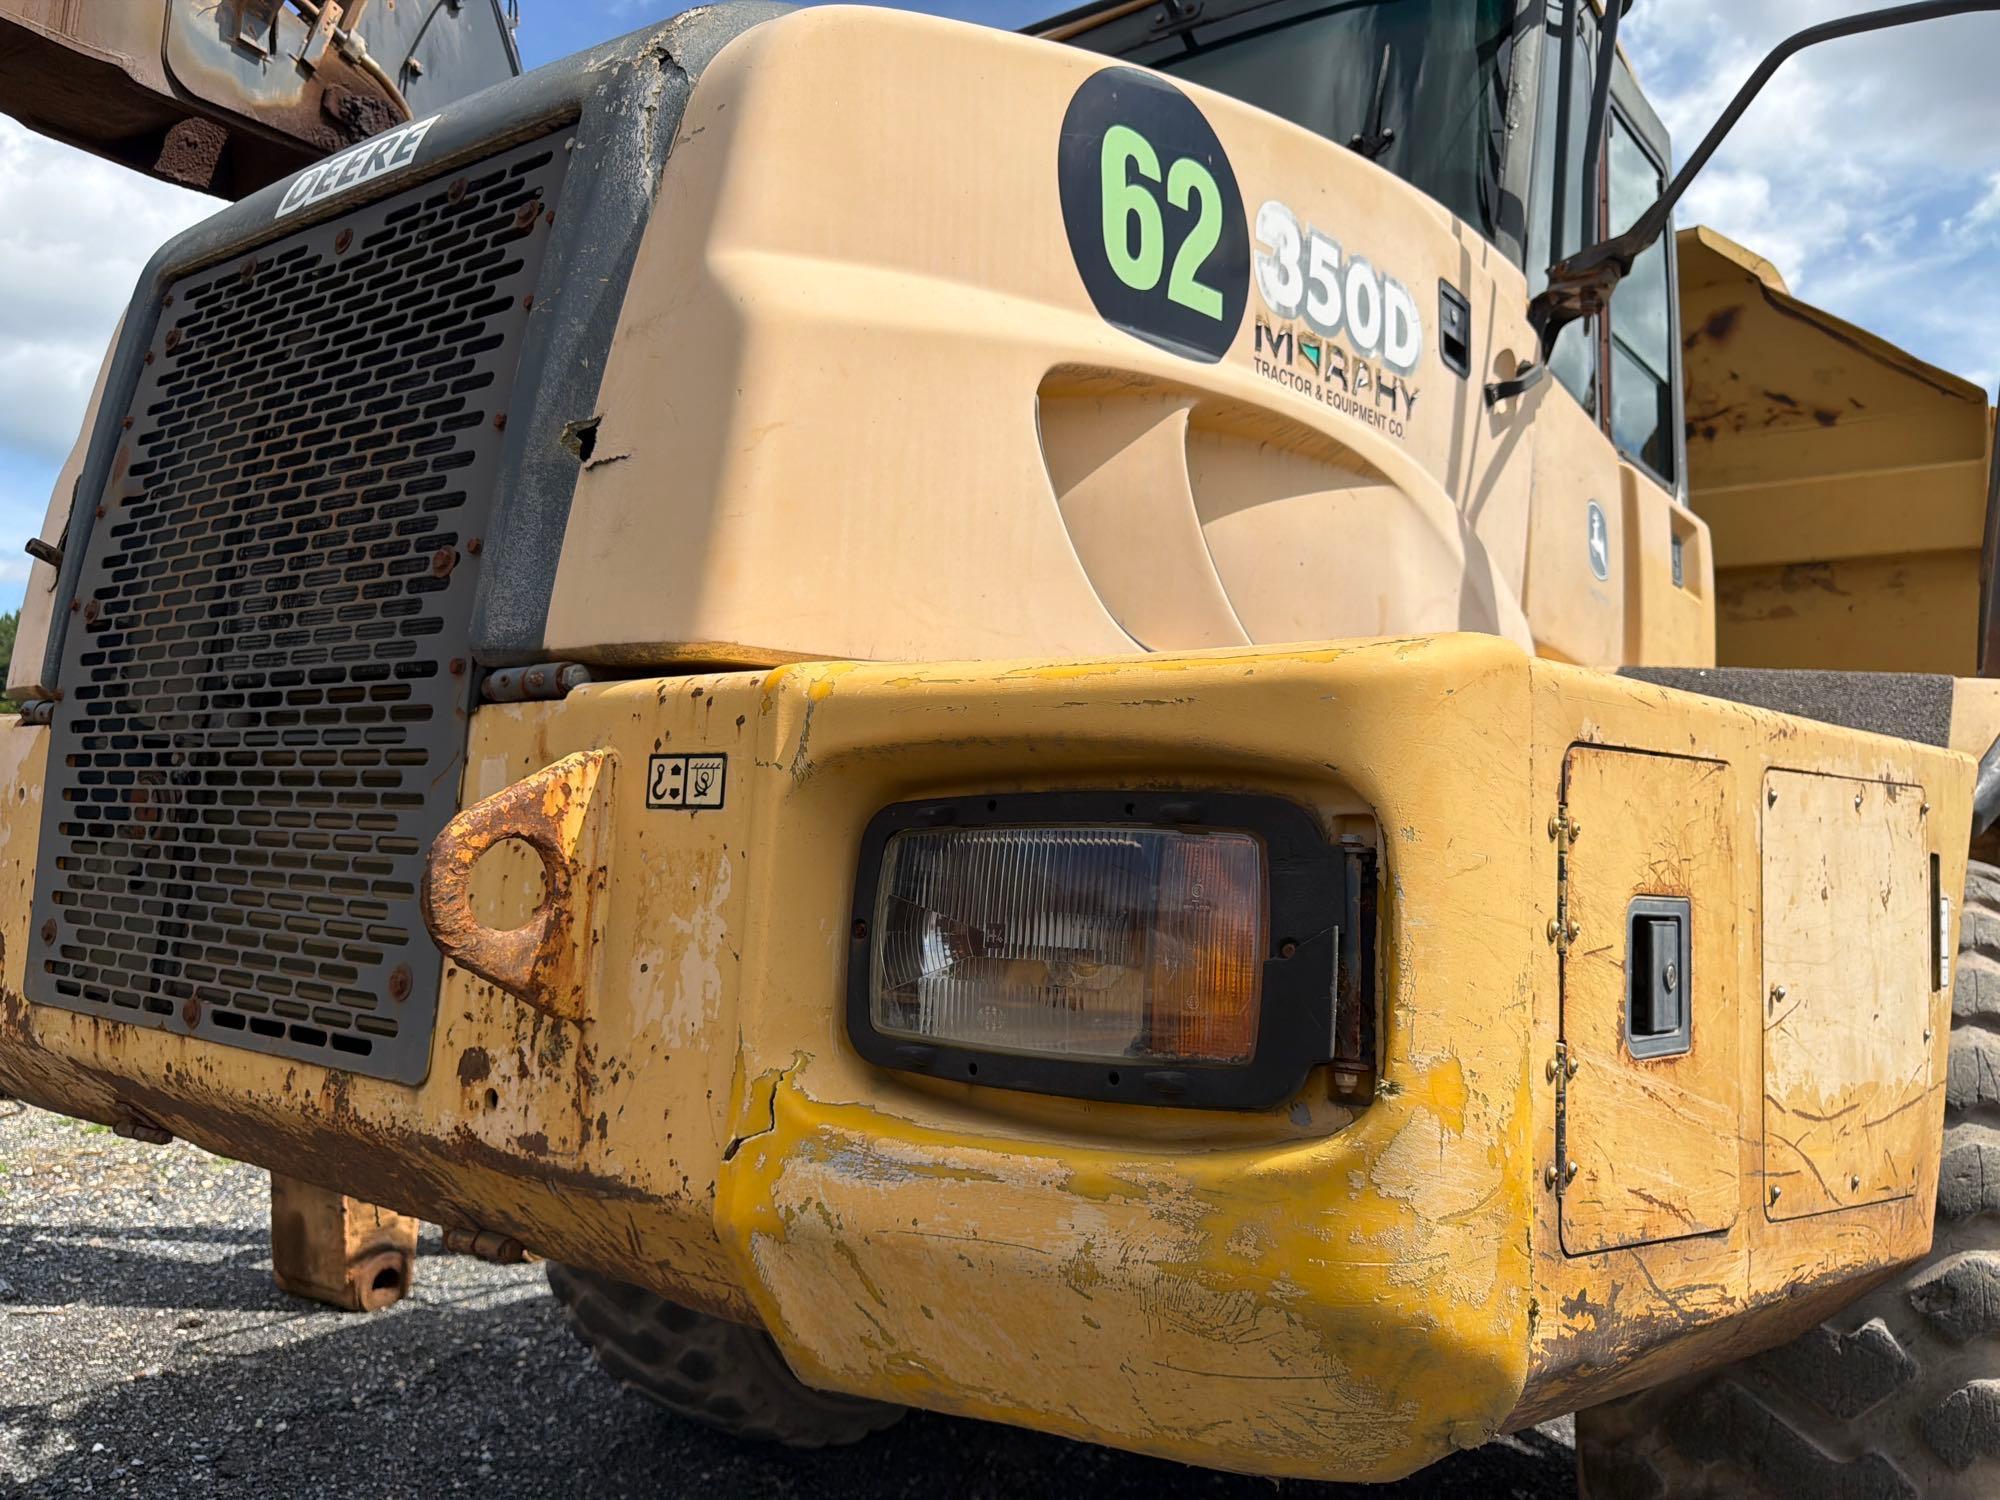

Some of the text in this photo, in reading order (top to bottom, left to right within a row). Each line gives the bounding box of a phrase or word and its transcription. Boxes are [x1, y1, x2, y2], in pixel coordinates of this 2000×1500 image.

[277, 116, 437, 216] DEERE
[1101, 125, 1223, 321] 62
[1254, 200, 1421, 373] 350D
[1254, 356, 1406, 440] TRACTOR & EQUIPMENT CO.
